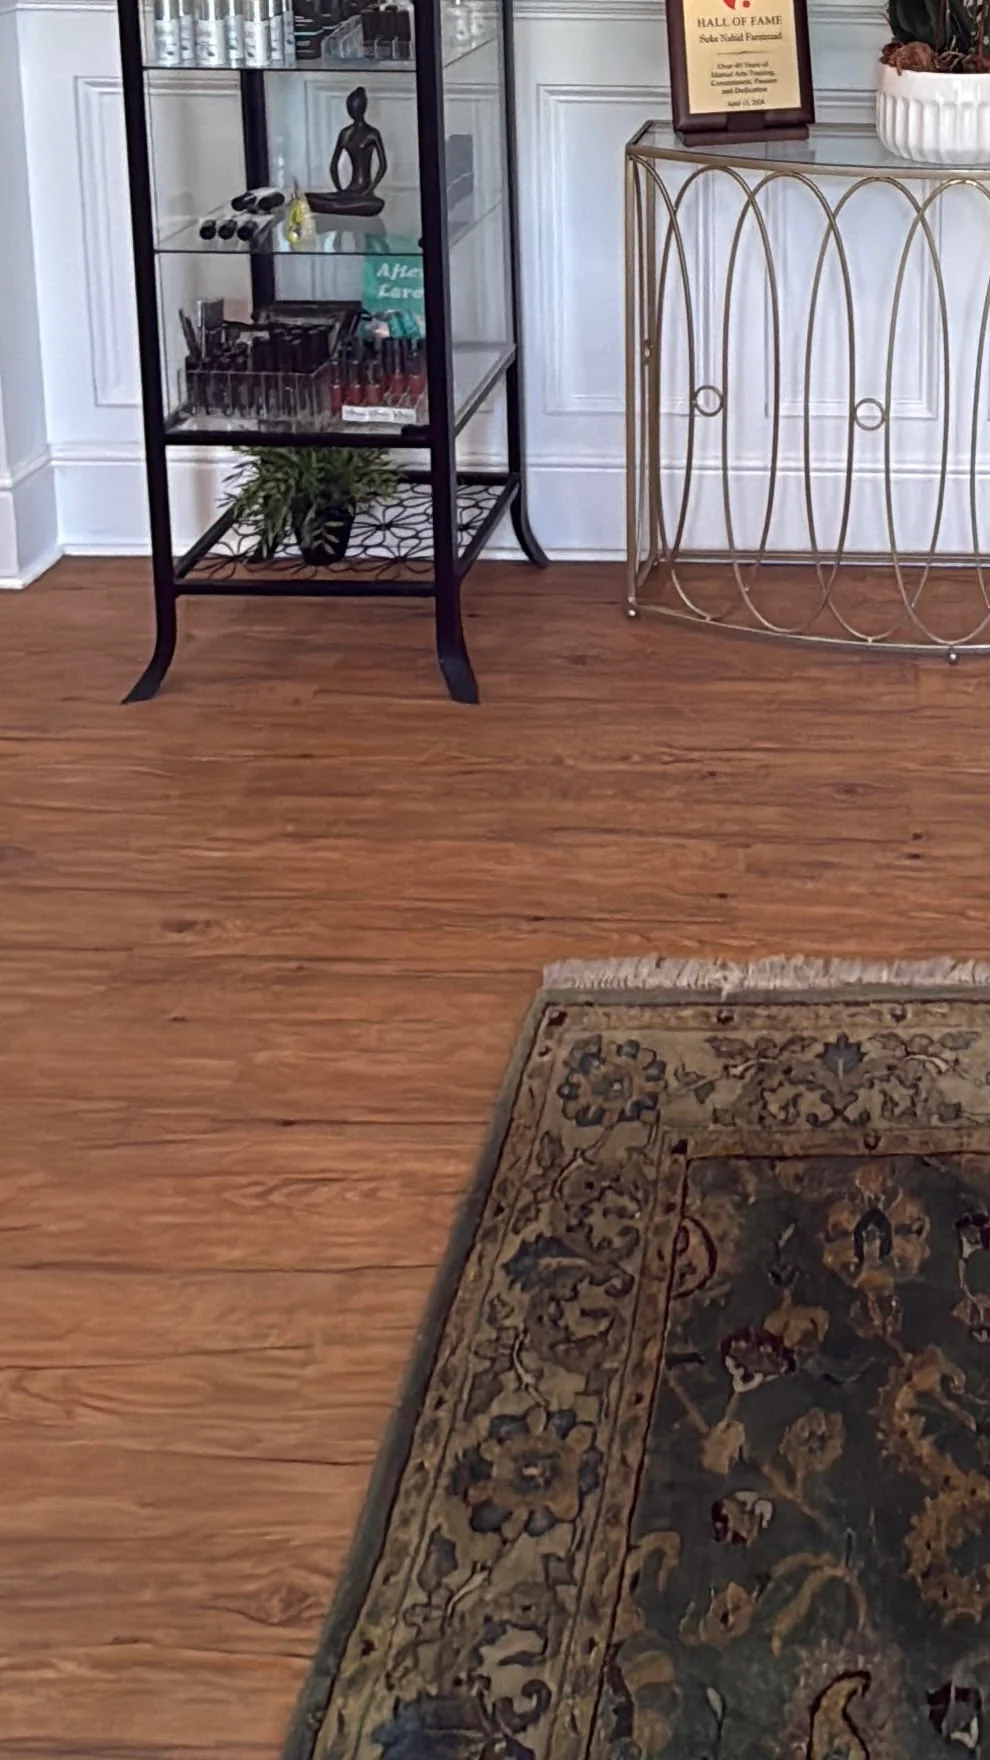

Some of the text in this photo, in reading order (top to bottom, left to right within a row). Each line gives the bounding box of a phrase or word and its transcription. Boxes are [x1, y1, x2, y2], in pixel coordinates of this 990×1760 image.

[697, 15, 783, 28] HALL OF FAME
